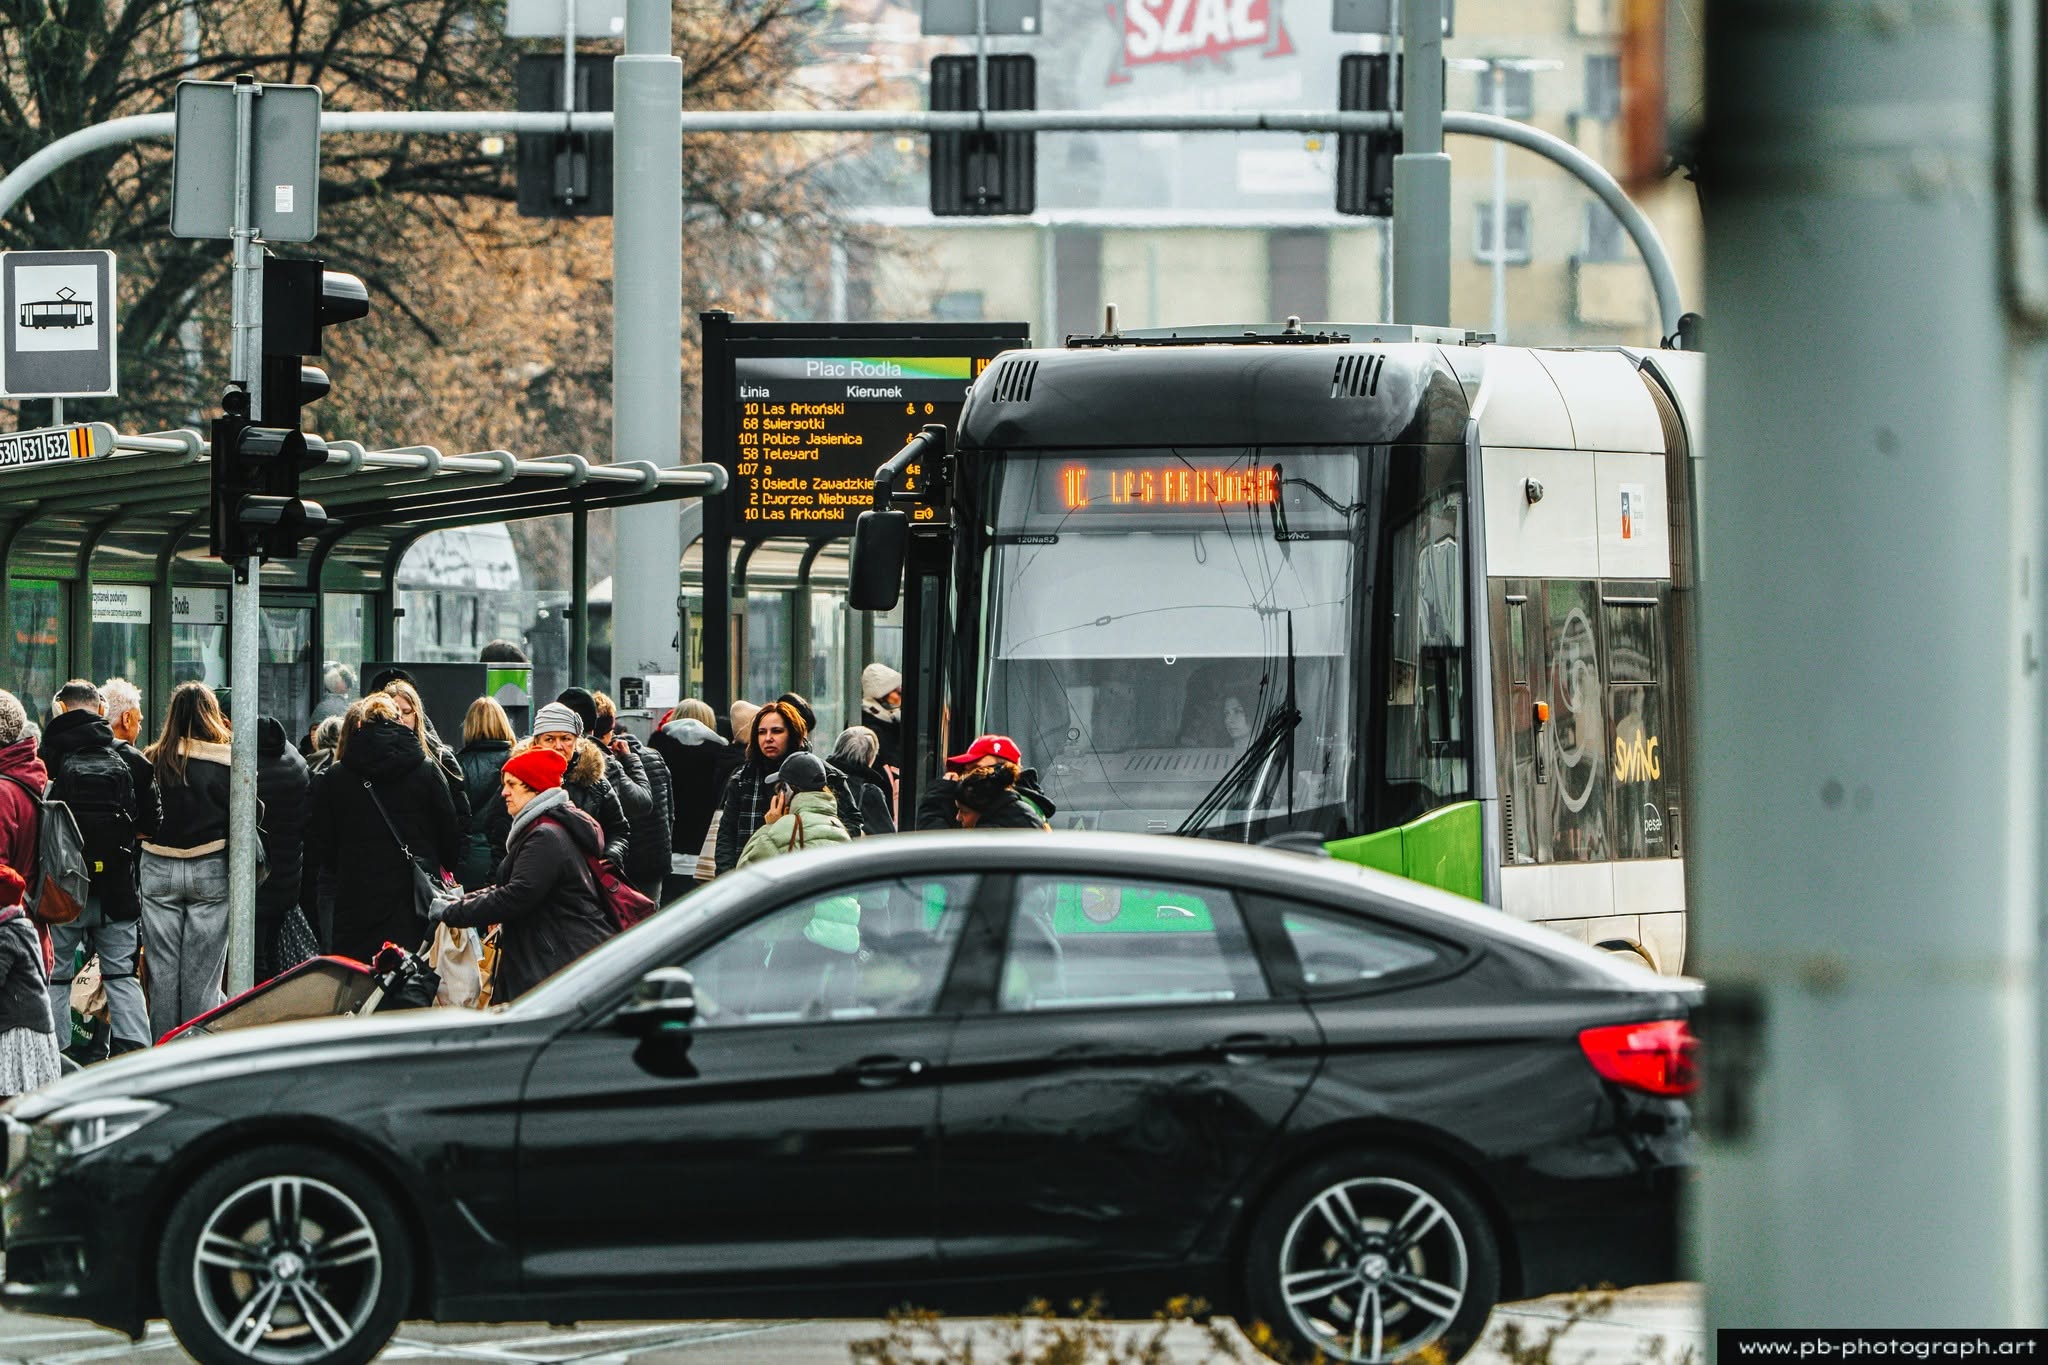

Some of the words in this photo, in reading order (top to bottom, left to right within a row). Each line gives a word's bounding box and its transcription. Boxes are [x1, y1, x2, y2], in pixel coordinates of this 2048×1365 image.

[806, 360, 846, 377] Plac
[850, 360, 902, 377] Rodła
[740, 385, 770, 398] Linia
[846, 385, 903, 398] Kierunek
[744, 402, 759, 415] 10
[762, 402, 786, 415] Las
[790, 402, 845, 415] Arkoński
[743, 418, 759, 430] 68
[738, 432, 759, 445] 101
[762, 432, 801, 445] Police
[805, 432, 863, 445] Jasienica
[22, 437, 43, 461] 531
[47, 434, 69, 458] 532
[743, 447, 759, 460] 58
[762, 447, 819, 460] Teleyard
[737, 462, 759, 475] 107
[750, 477, 759, 490] 3
[762, 477, 808, 490] Osiedle
[812, 477, 875, 490] Zawadzkie
[750, 492, 759, 505] 2
[818, 492, 874, 505] Niebusze
[744, 507, 759, 520] 10
[762, 507, 786, 520] Las
[790, 507, 845, 520] Arkoński
[1614, 728, 1661, 783] SWING
[76, 977, 90, 985] KFC
